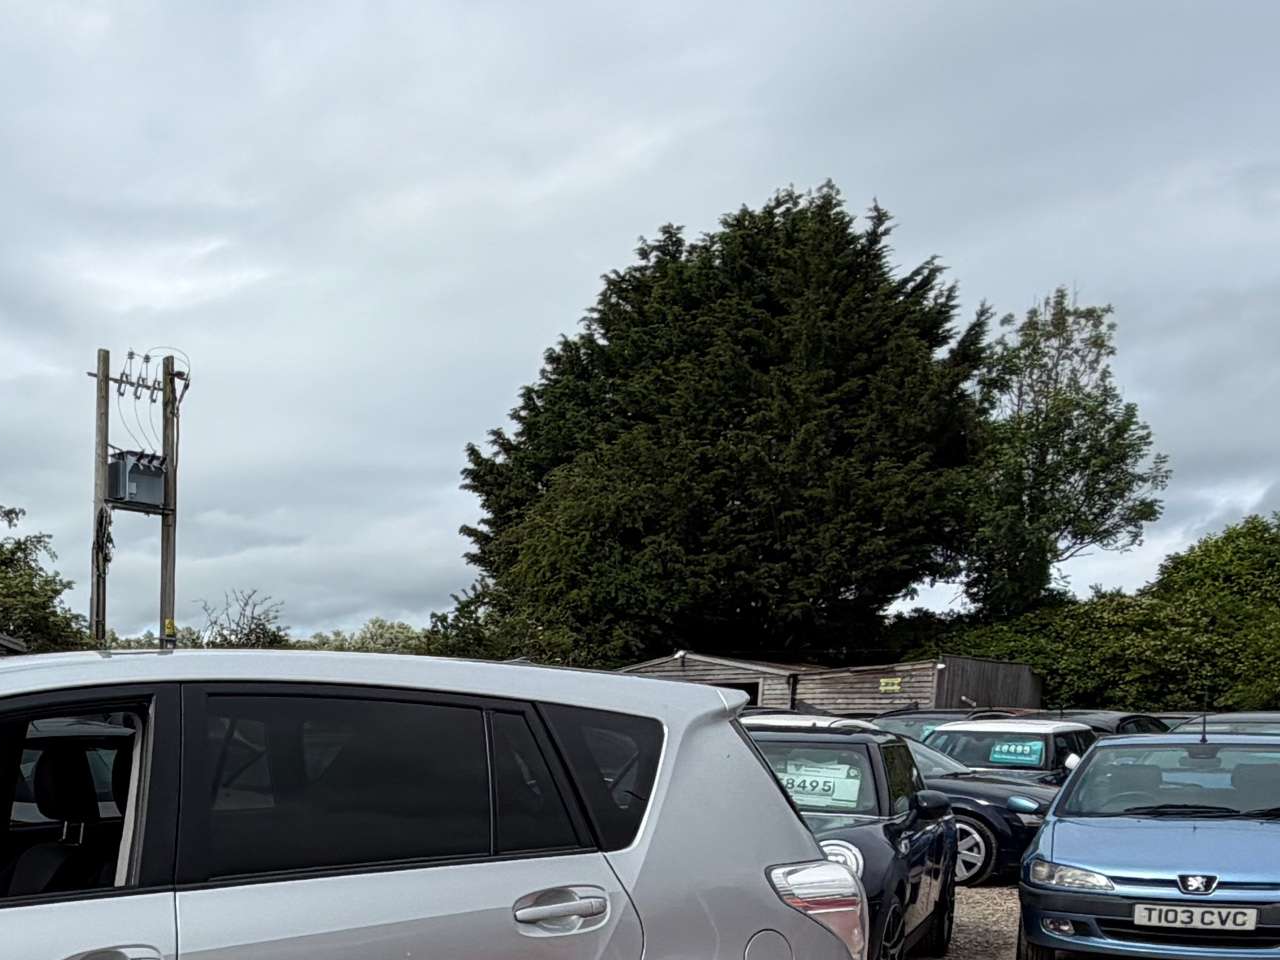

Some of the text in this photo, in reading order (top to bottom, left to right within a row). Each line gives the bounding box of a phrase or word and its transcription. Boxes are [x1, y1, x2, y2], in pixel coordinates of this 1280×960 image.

[780, 777, 833, 793] 8495
[1144, 907, 1248, 927] T103 CVC
